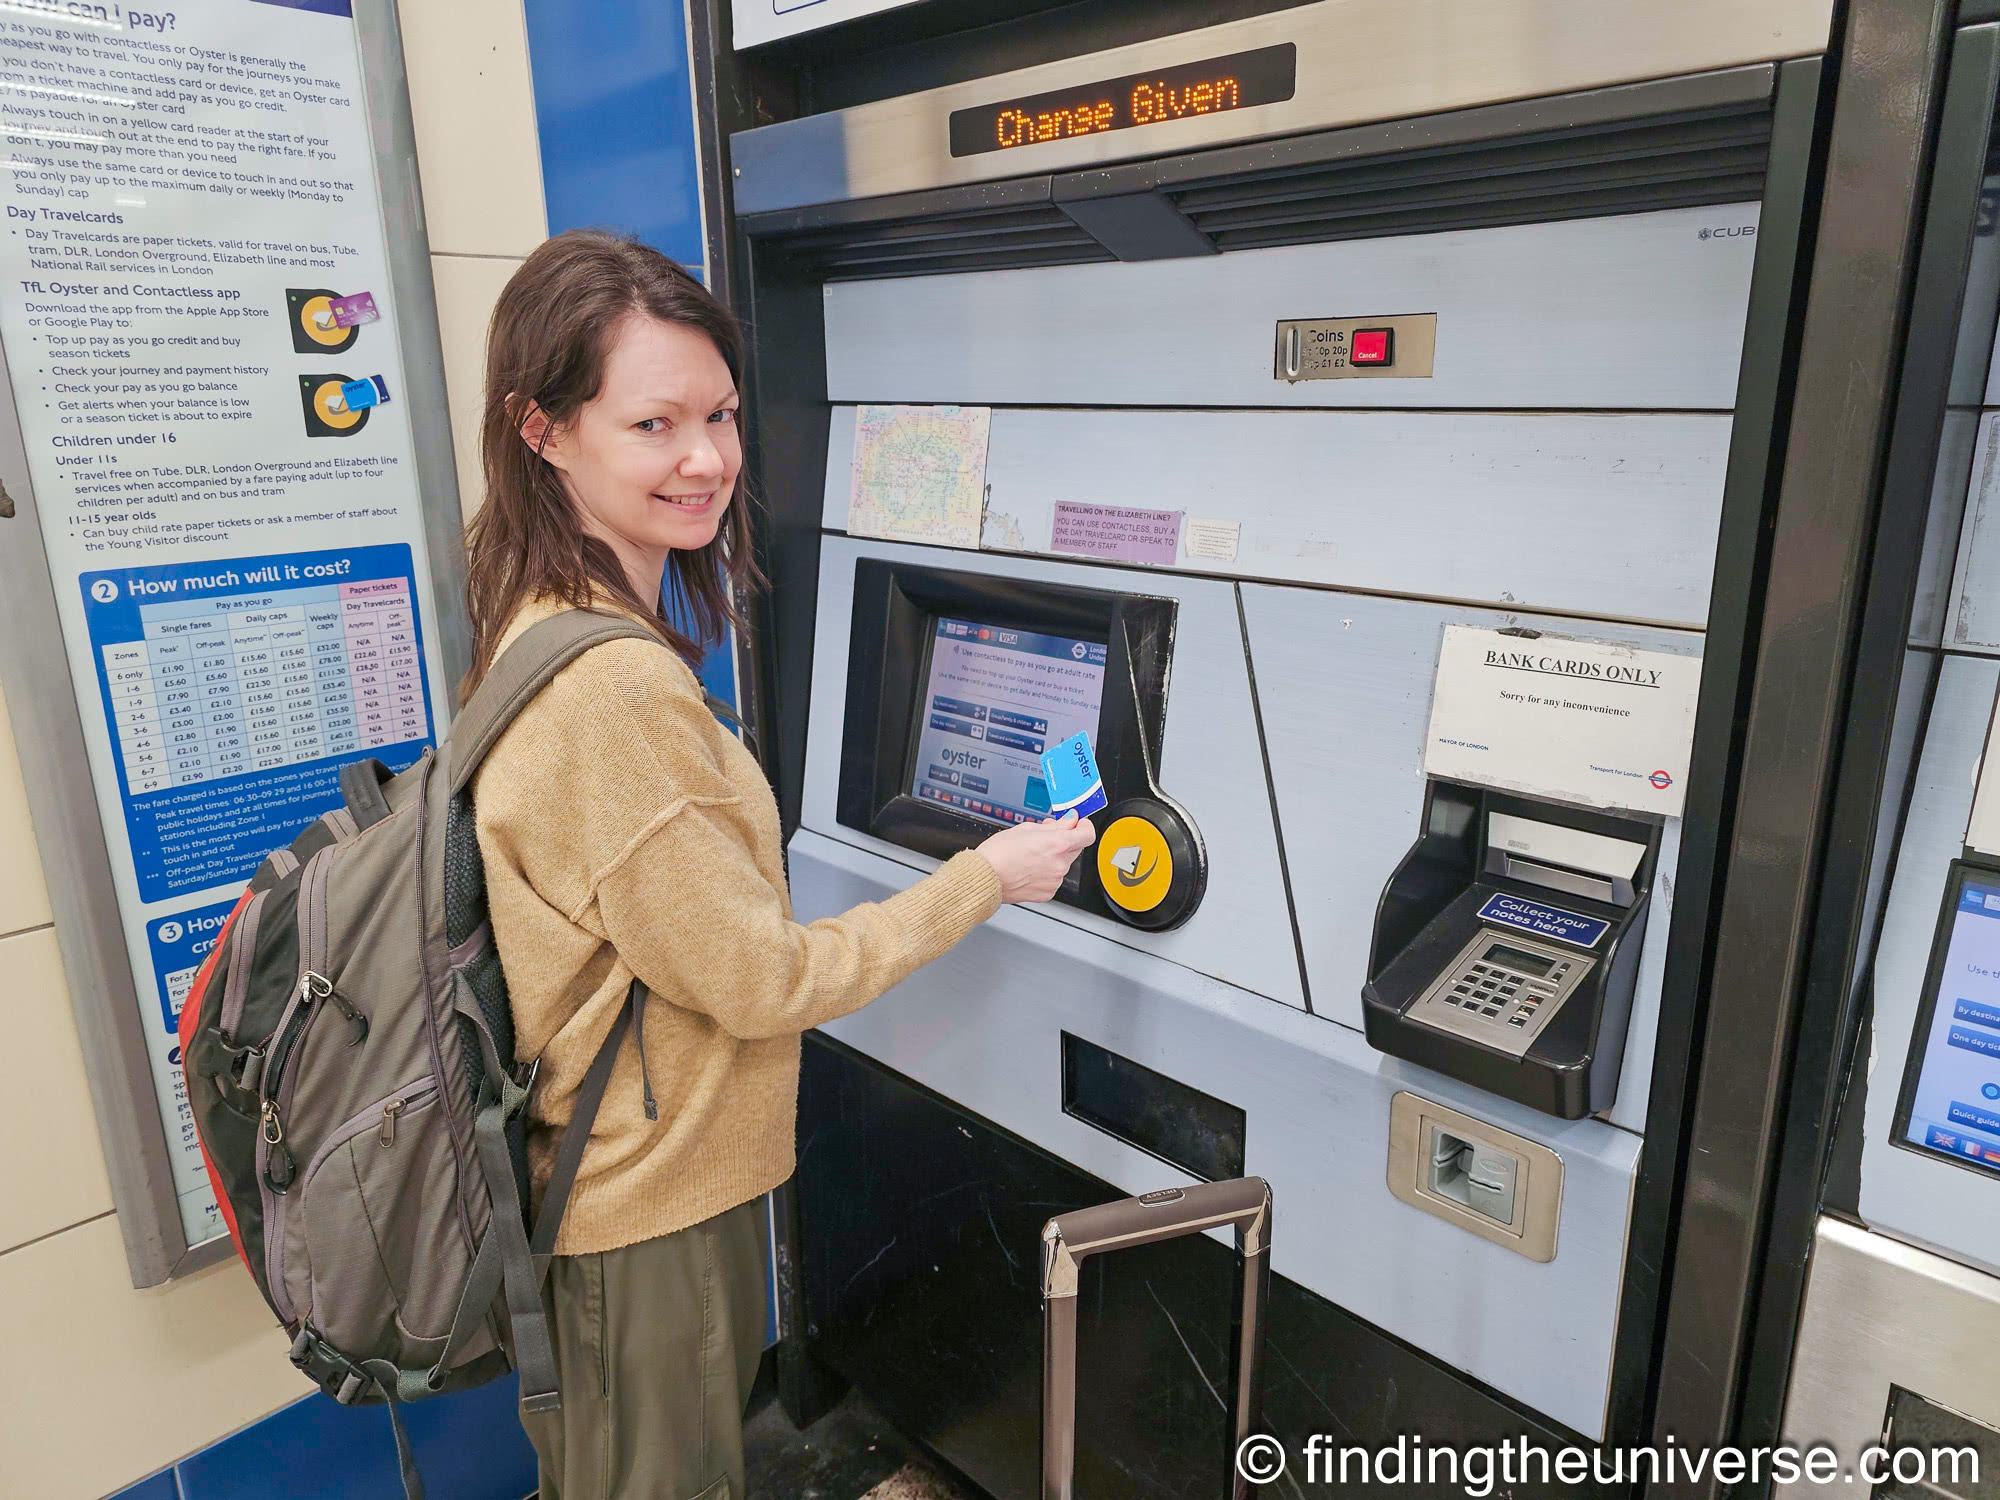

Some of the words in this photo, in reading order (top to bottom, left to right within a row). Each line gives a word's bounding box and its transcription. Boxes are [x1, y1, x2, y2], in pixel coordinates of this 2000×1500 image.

[128, 10, 176, 33] pay?
[1132, 78, 1238, 124] Given
[6, 206, 36, 221] Day
[40, 208, 124, 224] Travelcards
[1713, 227, 1755, 237] CUB
[31, 259, 82, 270] National
[86, 261, 107, 272] Rail
[110, 264, 156, 273] services
[158, 264, 169, 273] in
[172, 265, 214, 278] London
[20, 281, 46, 294] TfL
[50, 282, 99, 297] Oyster
[103, 284, 129, 295] and
[133, 285, 214, 299] Contactless
[217, 288, 241, 300] app
[93, 349, 131, 358] tickets
[1333, 346, 1348, 355] 20p
[1335, 359, 1345, 367] £2
[52, 367, 88, 376] Check
[91, 368, 117, 377] your
[119, 367, 160, 377] journey
[163, 366, 183, 375] and
[186, 366, 232, 376] payment
[234, 365, 269, 376] history
[55, 384, 91, 393] Check
[93, 385, 119, 394] your
[122, 384, 142, 394] pay
[144, 384, 157, 392] as
[159, 384, 180, 393] you
[183, 384, 196, 392] go
[198, 382, 238, 391] balance
[52, 436, 112, 447] Children
[117, 434, 156, 445] under
[162, 432, 177, 443] 16
[55, 456, 93, 465] Under
[99, 455, 118, 463] 11s
[69, 514, 101, 525] 11-15
[104, 512, 129, 524] year
[132, 511, 157, 520] olds
[1058, 505, 1093, 515] TRAVELLING
[1117, 510, 1151, 519] ELIZABETH
[1071, 519, 1084, 527] CAN
[1060, 538, 1086, 546] MEMBER
[1070, 529, 1083, 537] DAY
[1085, 530, 1126, 541] TRAVELCARD
[1128, 534, 1138, 542] OR
[1140, 536, 1162, 544] SPEAK
[1164, 538, 1174, 546] TO
[128, 579, 177, 596] How
[183, 571, 240, 590] much
[244, 566, 281, 584] will
[285, 565, 299, 580] it
[304, 559, 351, 578] cost?
[98, 583, 111, 598] 2
[349, 586, 372, 594] Paper
[373, 582, 398, 591] tickets
[216, 602, 231, 610] Pay
[245, 599, 260, 608] you
[263, 597, 272, 605] go
[346, 603, 361, 611] Day
[363, 598, 405, 608] Travelcards
[246, 615, 267, 623] Daily
[269, 612, 288, 620] caps
[310, 613, 338, 622] Weekly
[161, 625, 188, 633] Single
[189, 622, 212, 630] fares
[316, 622, 334, 630] caps
[196, 640, 225, 649] Off-peak
[1001, 632, 1018, 644] VISA
[114, 652, 139, 660] Zones
[962, 649, 972, 657] Use
[974, 652, 1006, 662] contactless
[1015, 659, 1026, 668] pay
[1035, 662, 1046, 671] you
[1064, 667, 1082, 676] adult
[162, 664, 184, 674] £1.90
[203, 659, 225, 668] £1.80
[1485, 650, 1535, 668] BANK
[1539, 657, 1601, 677] CARDS
[1606, 665, 1662, 684] ONLY
[125, 670, 143, 679] only
[206, 673, 227, 681] £5.60
[165, 678, 187, 687] £5.60
[1500, 690, 1525, 703] Sorry
[1528, 694, 1541, 703] for
[1544, 698, 1561, 708] any
[1563, 700, 1631, 717] inconvenience
[941, 748, 987, 770] oyster
[1004, 759, 1019, 768] Touch
[1074, 741, 1092, 780] oyster
[1589, 765, 1614, 774] Transport
[160, 829, 195, 841] stations
[198, 820, 236, 833] including
[238, 816, 259, 825] Zone
[164, 854, 190, 865] touch
[192, 851, 200, 859] in
[202, 848, 218, 856] and
[220, 844, 235, 854] out
[1499, 899, 1554, 920] Collect
[1552, 916, 1590, 930] your
[188, 914, 230, 934] How
[1490, 908, 1531, 926] notes
[1535, 919, 1567, 935] here
[165, 925, 176, 939] 3
[1968, 963, 1988, 976] Use
[1958, 1006, 1968, 1014] By
[1952, 1033, 1969, 1042] One
[1971, 1038, 1986, 1048] day
[1952, 1108, 1975, 1120] Quick
[1976, 1114, 2000, 1128] guide
